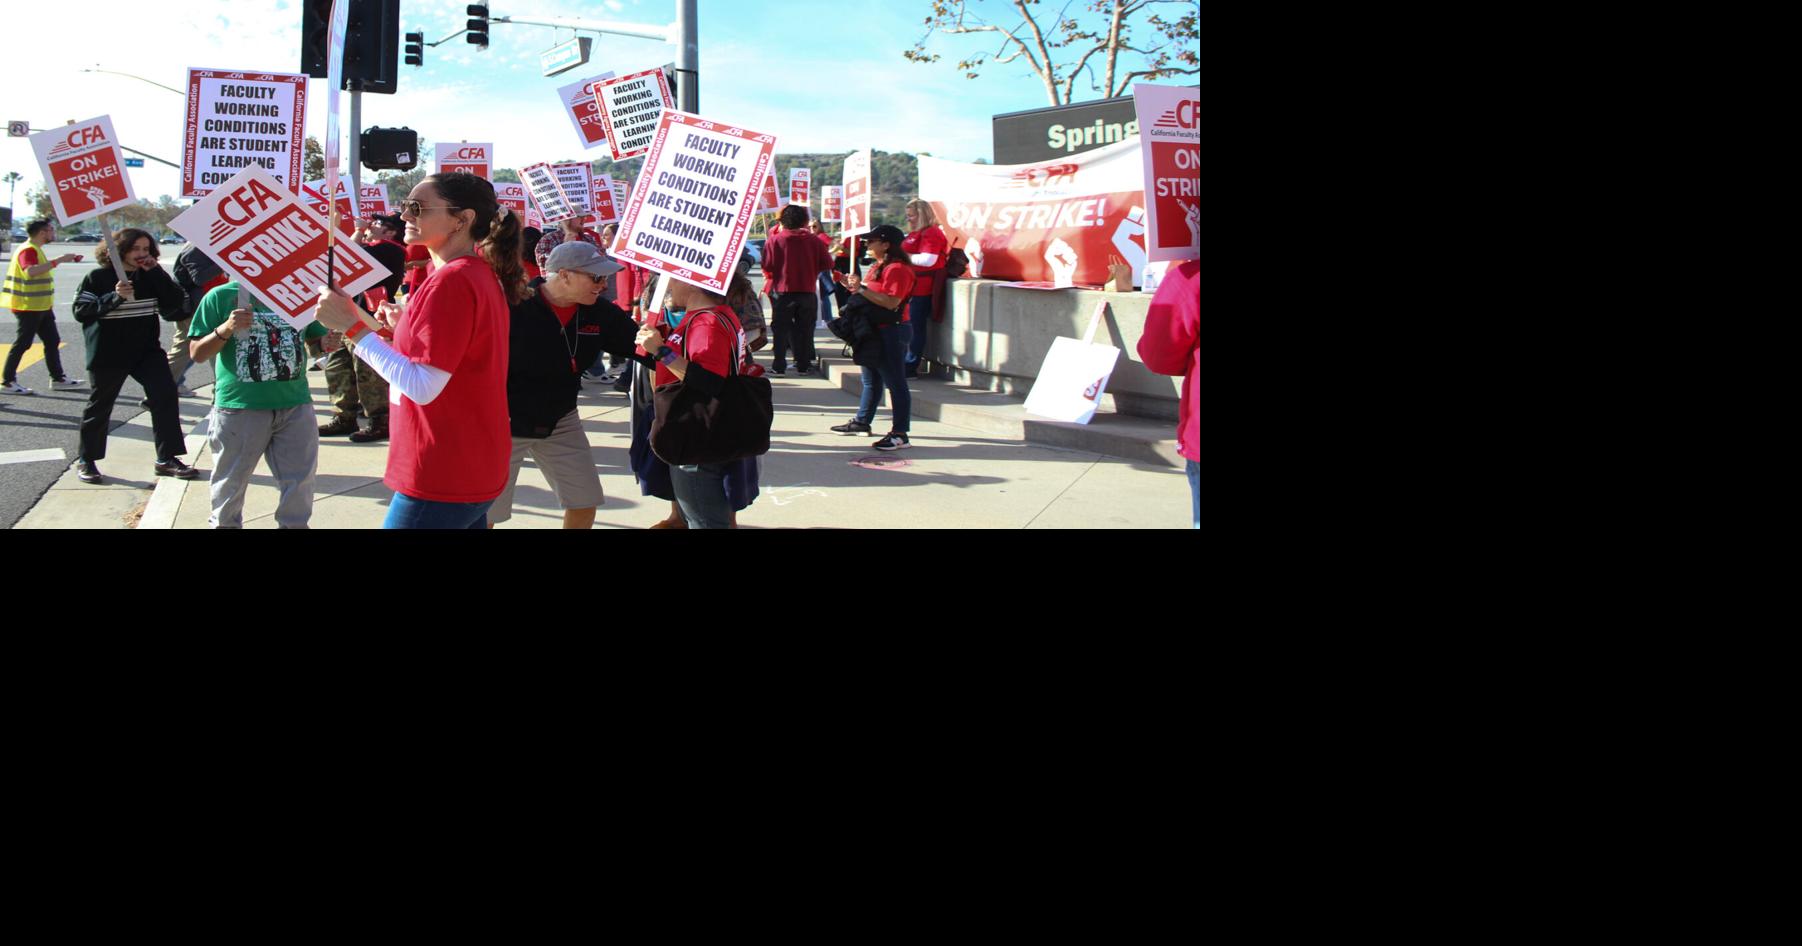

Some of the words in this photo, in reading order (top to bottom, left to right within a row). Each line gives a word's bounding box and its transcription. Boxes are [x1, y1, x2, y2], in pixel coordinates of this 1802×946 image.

[220, 84, 276, 99] FACULTY
[613, 80, 646, 95] FACULTY
[613, 89, 652, 106] WORKING
[214, 102, 279, 117] WORKING
[612, 98, 661, 118] CONDITIONS
[613, 118, 628, 129] ARE
[629, 110, 661, 125] STUDEN
[1176, 99, 1200, 129] CF
[67, 124, 105, 148] CFA
[204, 119, 286, 135] CONDITIONS
[622, 122, 657, 138] LEARNIN
[200, 137, 226, 150] ARE
[228, 138, 288, 152] STUDENT
[458, 147, 485, 159] CFA
[684, 133, 741, 160] FACULTY
[71, 155, 98, 171] ON
[673, 153, 737, 182] WORKING
[750, 153, 769, 193] California
[58, 165, 118, 191] STRIKE!
[320, 181, 346, 196] CA
[594, 178, 606, 187] FA
[620, 201, 640, 240] California
[635, 173, 653, 200] Faculty
[647, 127, 667, 173] Association
[1157, 177, 1200, 197] STRI
[218, 178, 282, 226] CFA
[506, 187, 523, 196] CFA
[647, 191, 673, 211] ARE
[673, 196, 734, 227] STUDENT
[737, 195, 756, 223] Faculty
[994, 197, 1106, 229] STRIKE!
[651, 214, 714, 246] LEARNING
[228, 212, 323, 278] STRIKE
[636, 232, 715, 270] CONDITIONS
[720, 226, 744, 273] Association
[266, 244, 364, 312] READY!
